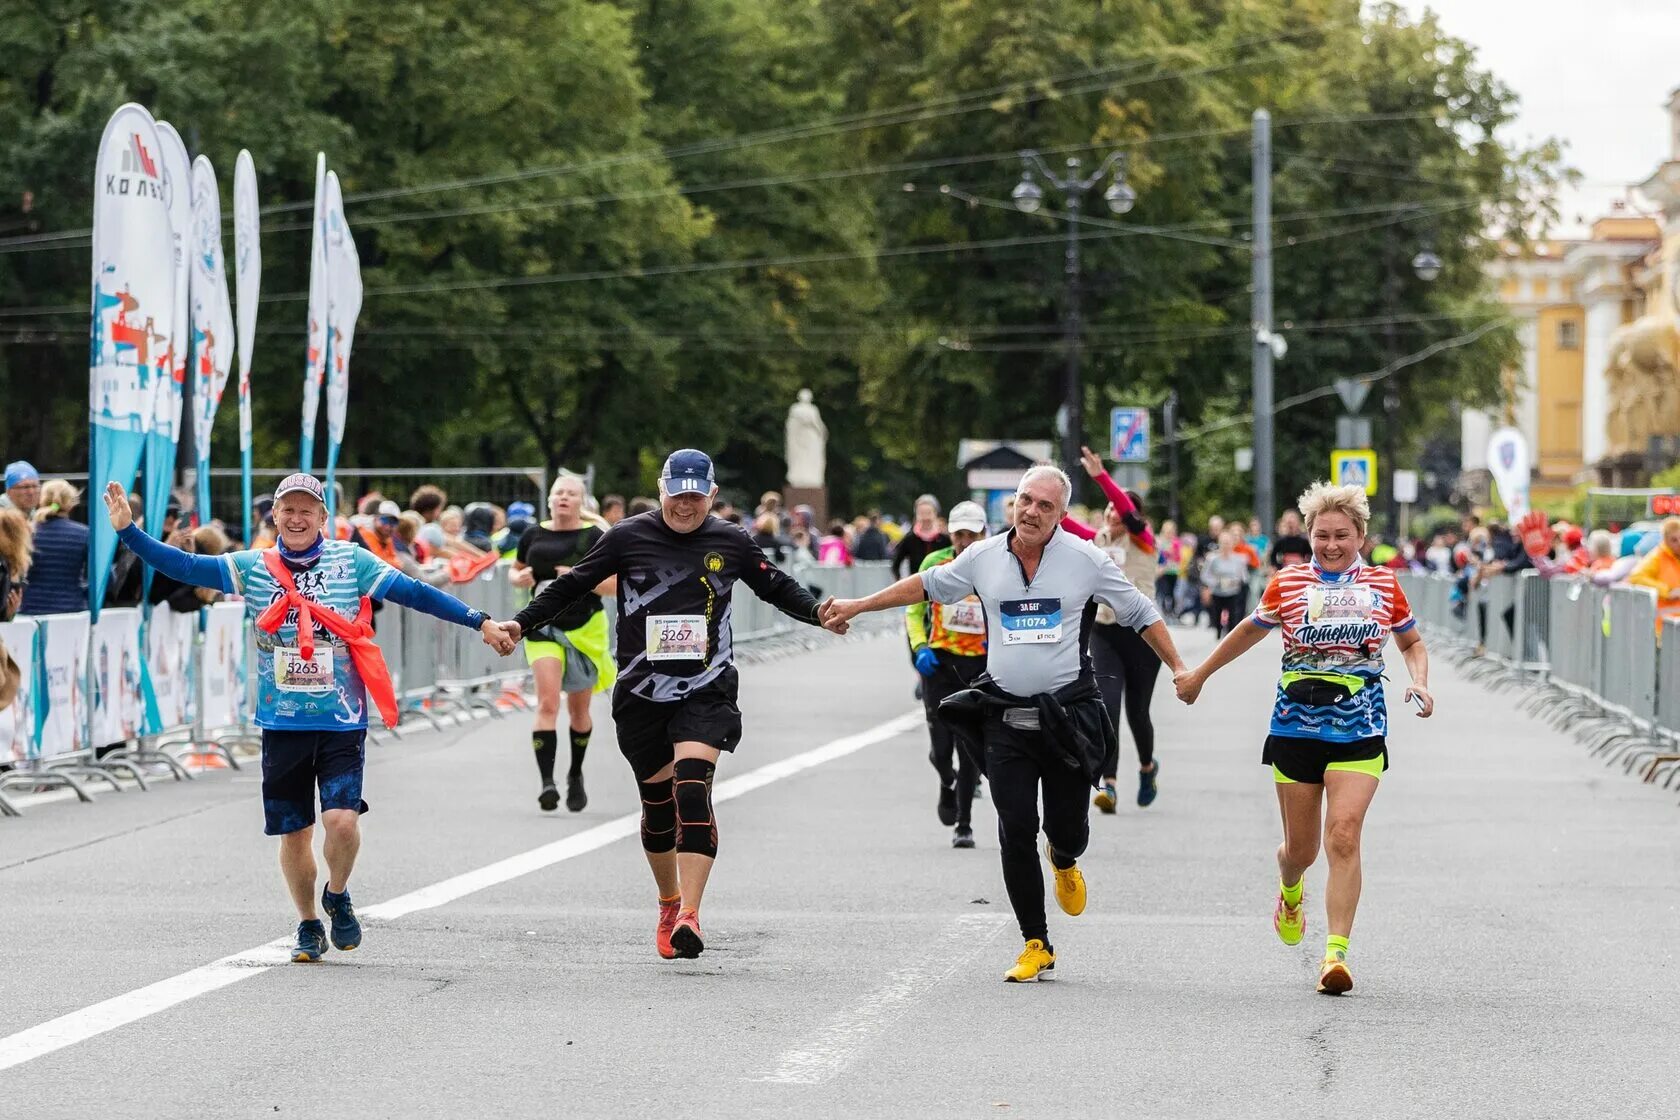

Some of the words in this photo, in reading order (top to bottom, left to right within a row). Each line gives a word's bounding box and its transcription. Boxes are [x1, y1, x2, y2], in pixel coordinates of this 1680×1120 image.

[1324, 595, 1357, 607] 5266
[1015, 617, 1047, 628] 11074
[660, 629, 692, 642] 5267
[1008, 633, 1014, 641] 5
[287, 662, 318, 674] 5265
